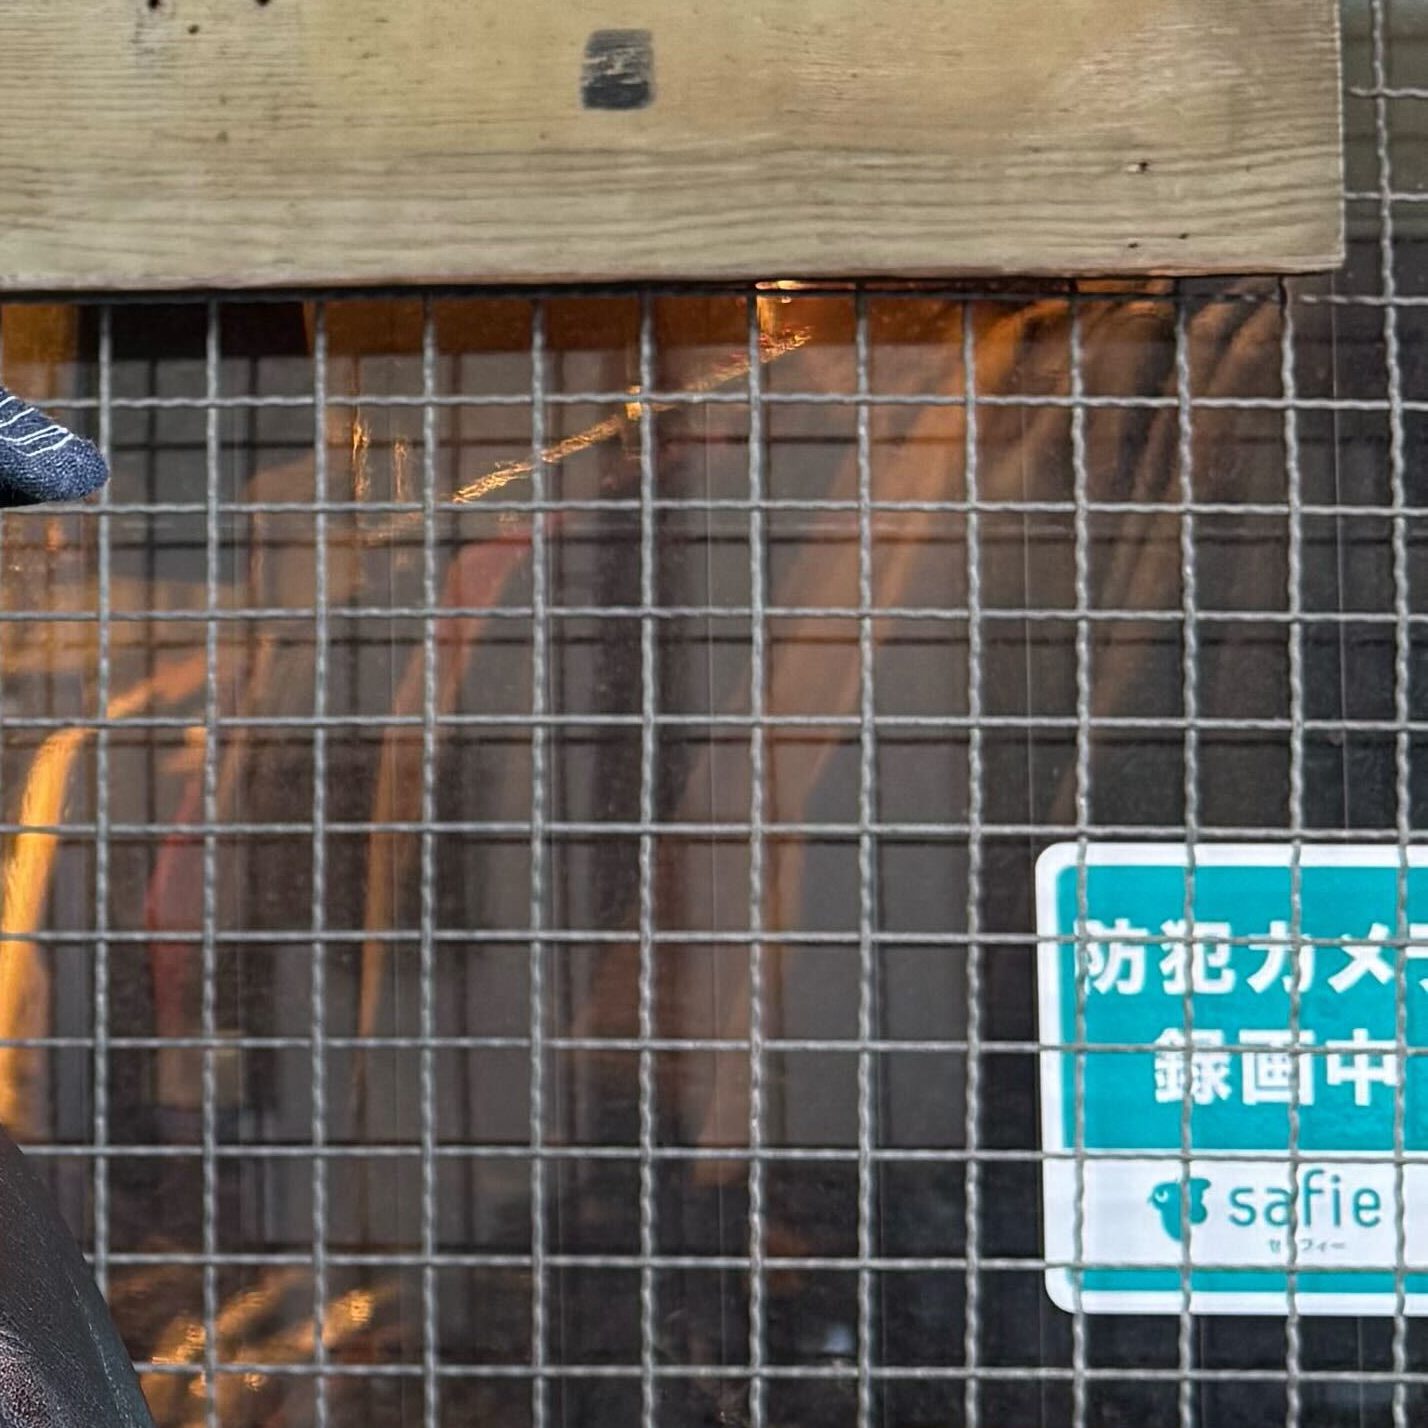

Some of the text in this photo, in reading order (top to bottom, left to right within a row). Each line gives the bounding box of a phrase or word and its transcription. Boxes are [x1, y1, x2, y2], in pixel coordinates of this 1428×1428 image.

[1154, 1027, 1401, 1107] 録画中
[1228, 1168, 1382, 1228] safie
[1268, 1237, 1347, 1254] セフィー
